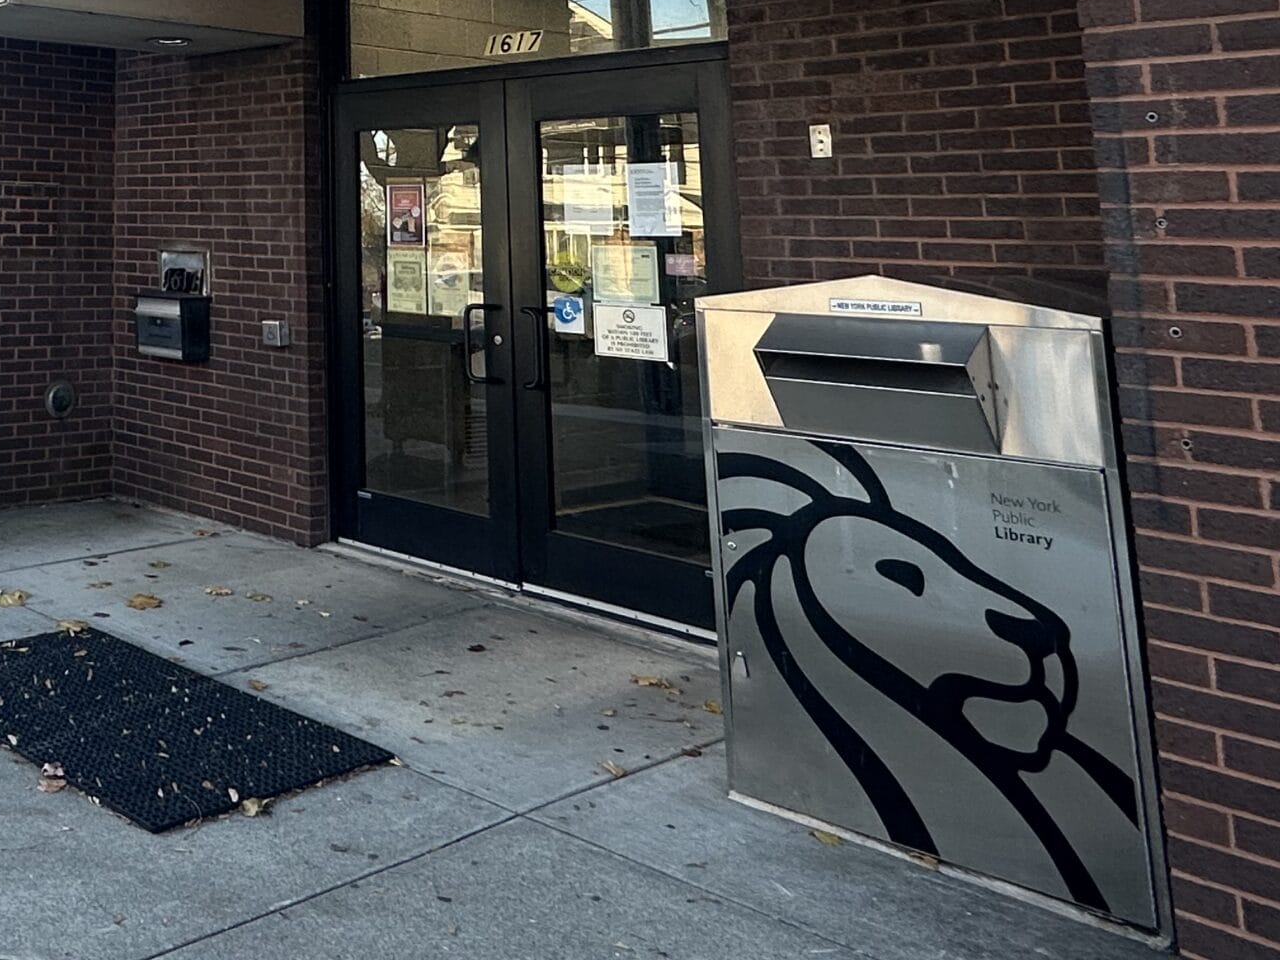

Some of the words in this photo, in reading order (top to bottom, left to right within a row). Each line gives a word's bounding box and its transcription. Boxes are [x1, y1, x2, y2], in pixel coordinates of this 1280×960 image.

[489, 31, 541, 54] 1617
[866, 303, 887, 311] PUBLIC
[887, 304, 913, 312] LIBRARY
[991, 493, 1024, 507] New
[1027, 496, 1061, 513] York
[992, 509, 1035, 528] Public
[995, 526, 1053, 551] Library
